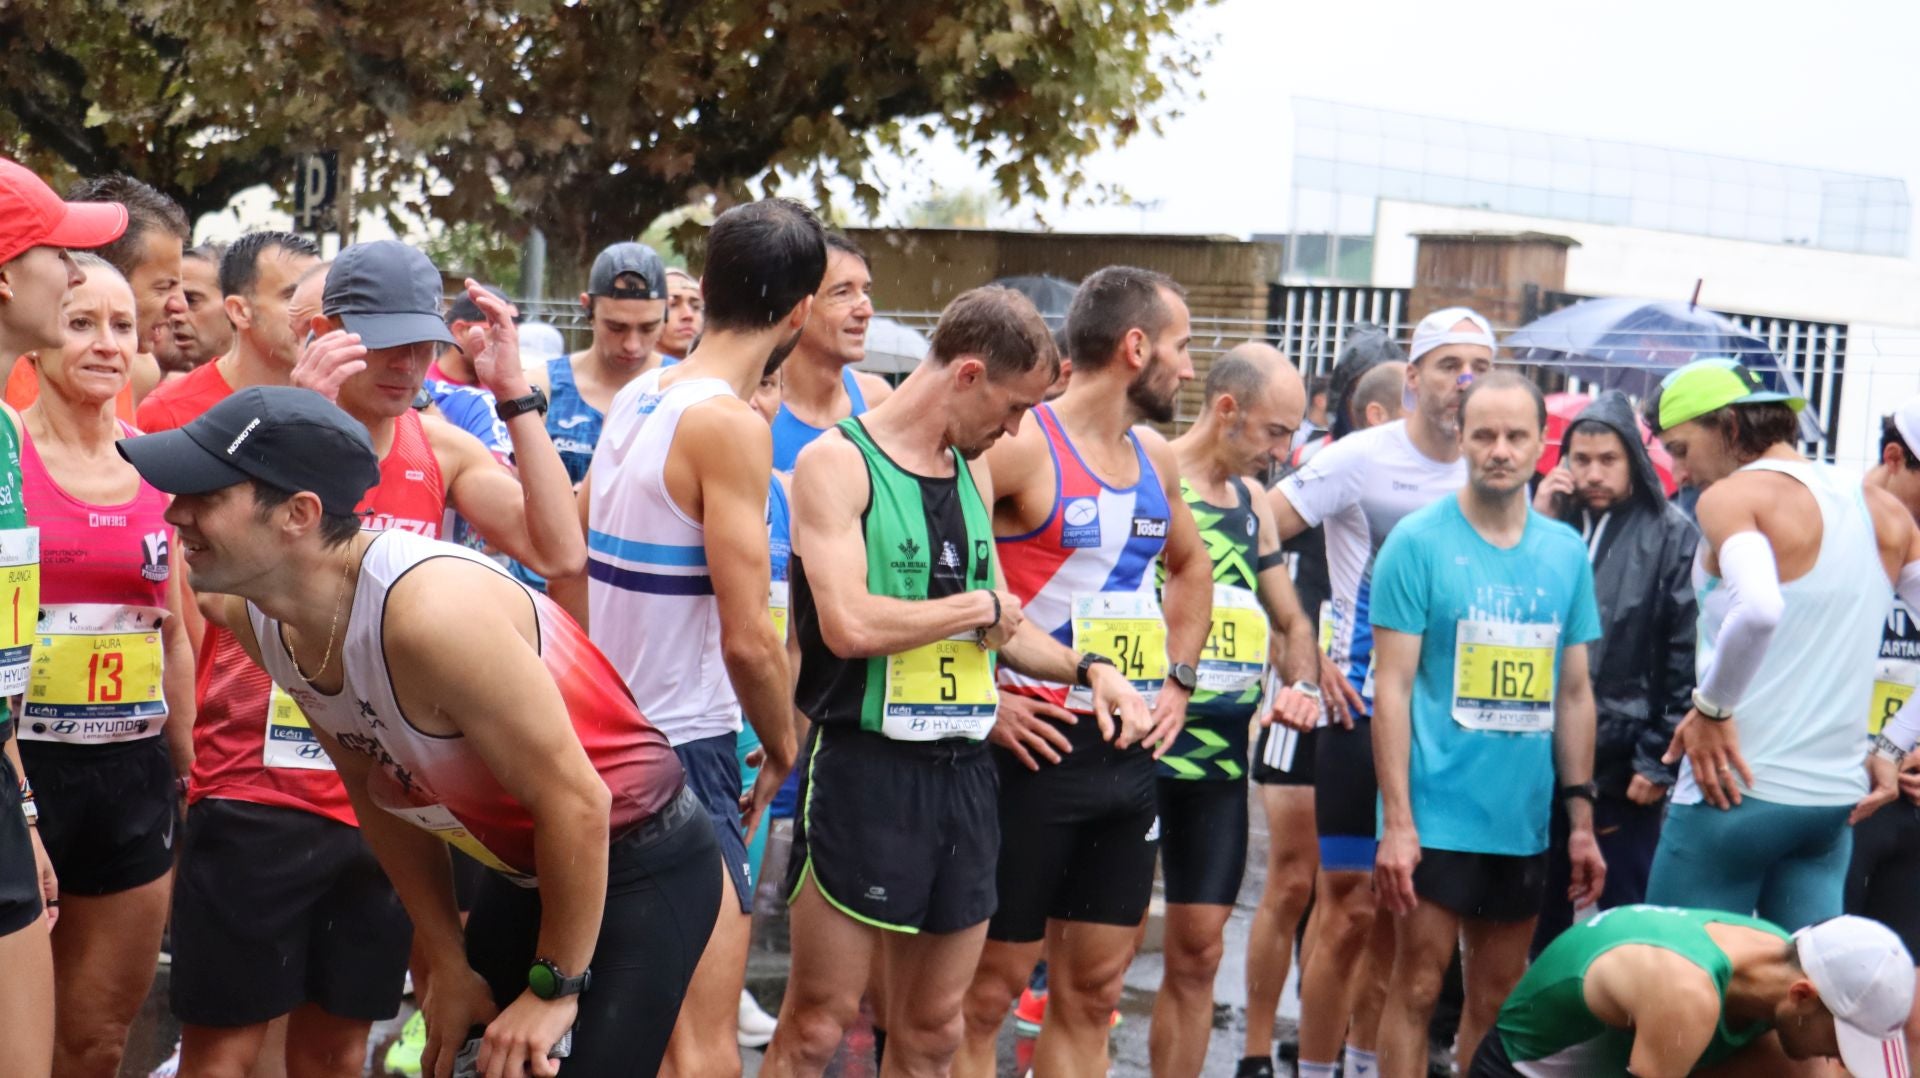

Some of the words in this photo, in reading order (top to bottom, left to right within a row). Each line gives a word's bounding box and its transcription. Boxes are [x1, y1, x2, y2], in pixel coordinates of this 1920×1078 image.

[304, 157, 327, 227] P
[226, 416, 261, 455] SALOMON
[1063, 529, 1099, 538] DEPORTE
[9, 571, 31, 584] BLANCA
[13, 587, 20, 644] 1
[93, 638, 121, 649] LAURA
[1114, 635, 1145, 677] 34
[1203, 621, 1236, 658] 49
[88, 652, 124, 702] 13
[940, 657, 956, 700] 5
[1491, 660, 1534, 698] 162
[933, 720, 981, 730] HYUNDAI
